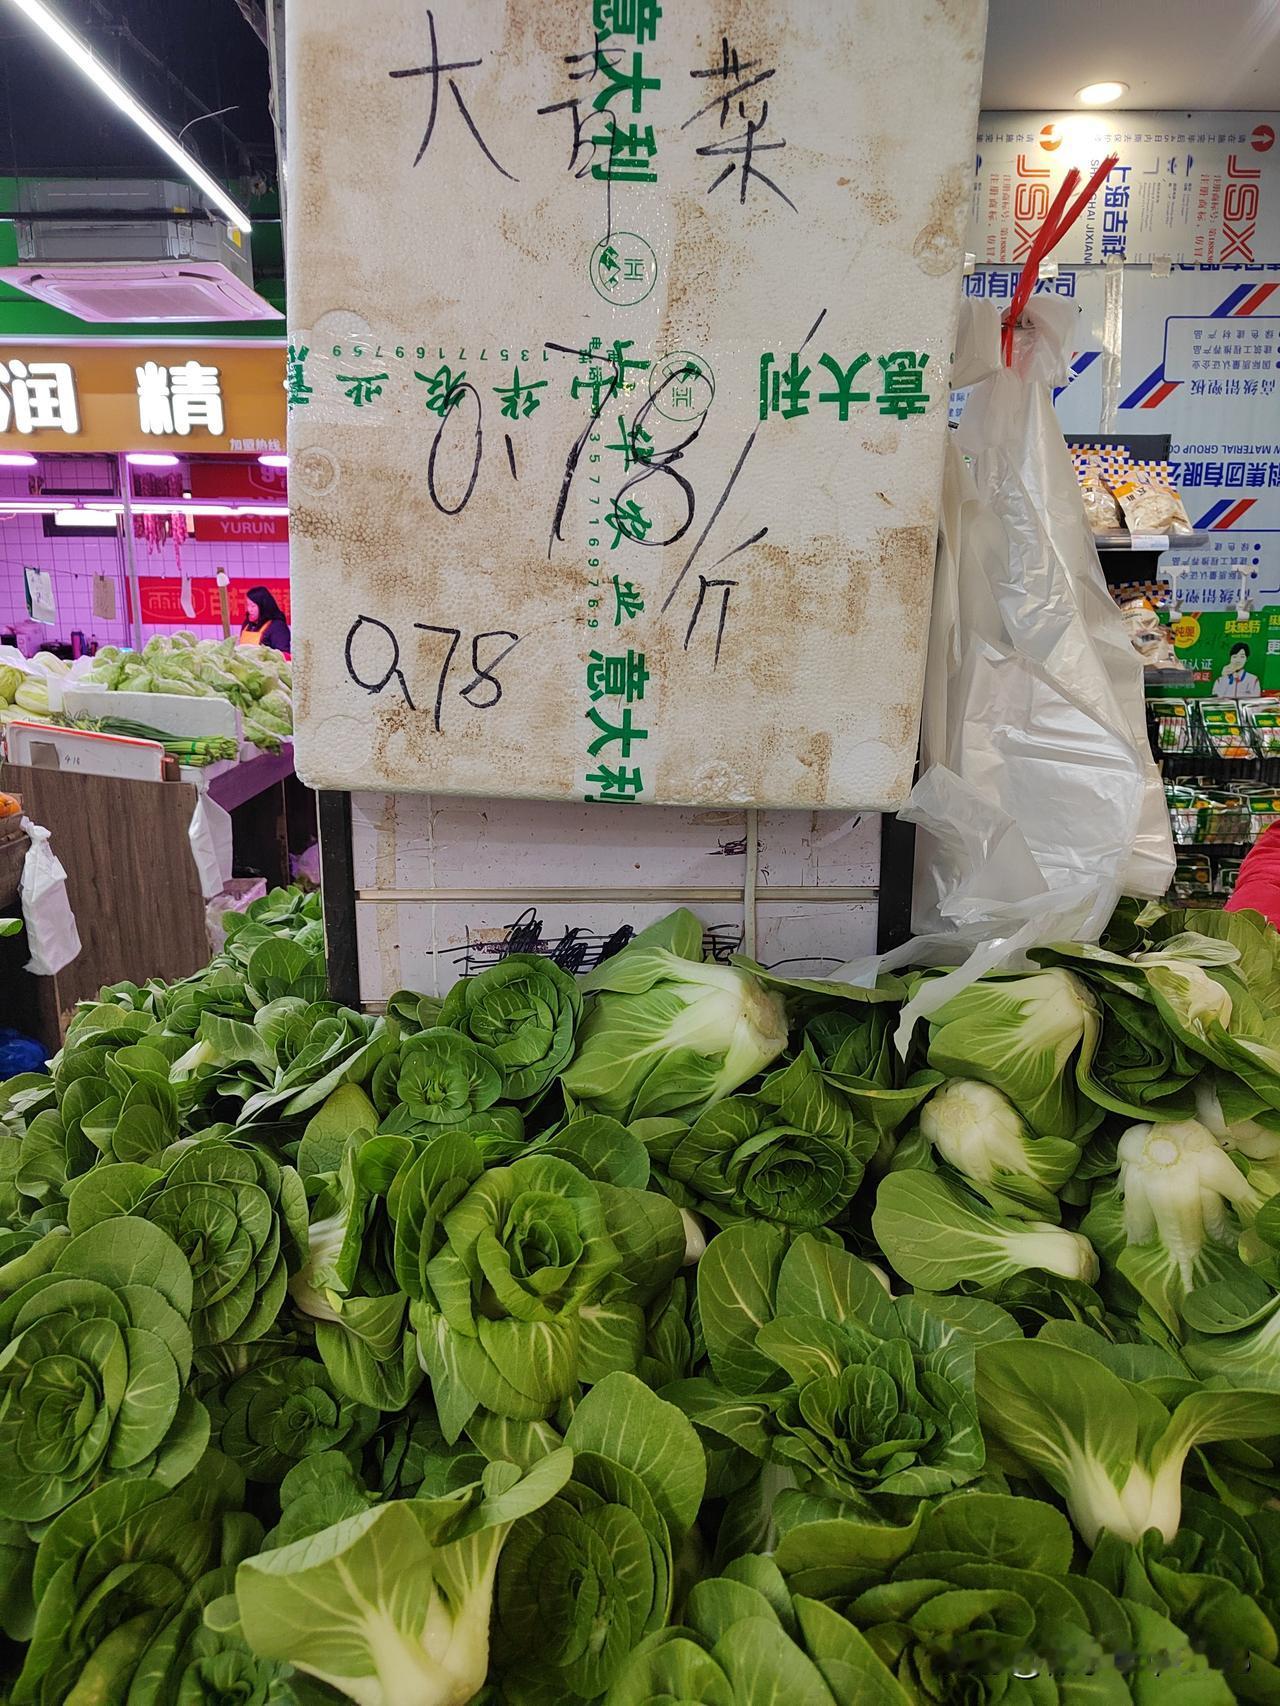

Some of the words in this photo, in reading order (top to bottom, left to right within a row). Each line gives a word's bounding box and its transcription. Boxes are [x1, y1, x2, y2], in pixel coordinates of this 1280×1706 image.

[1219, 155, 1261, 263] JSX
[1083, 224, 1095, 264] JIXIAN
[1191, 359, 1271, 370] 国际质量认证企业
[760, 350, 931, 423] 意大利
[1190, 379, 1276, 396] 高级铝塑板
[135, 360, 225, 436] 精
[1182, 444, 1219, 455] GROUP
[1221, 445, 1271, 455] MATERIAL
[220, 521, 276, 534] YURUN
